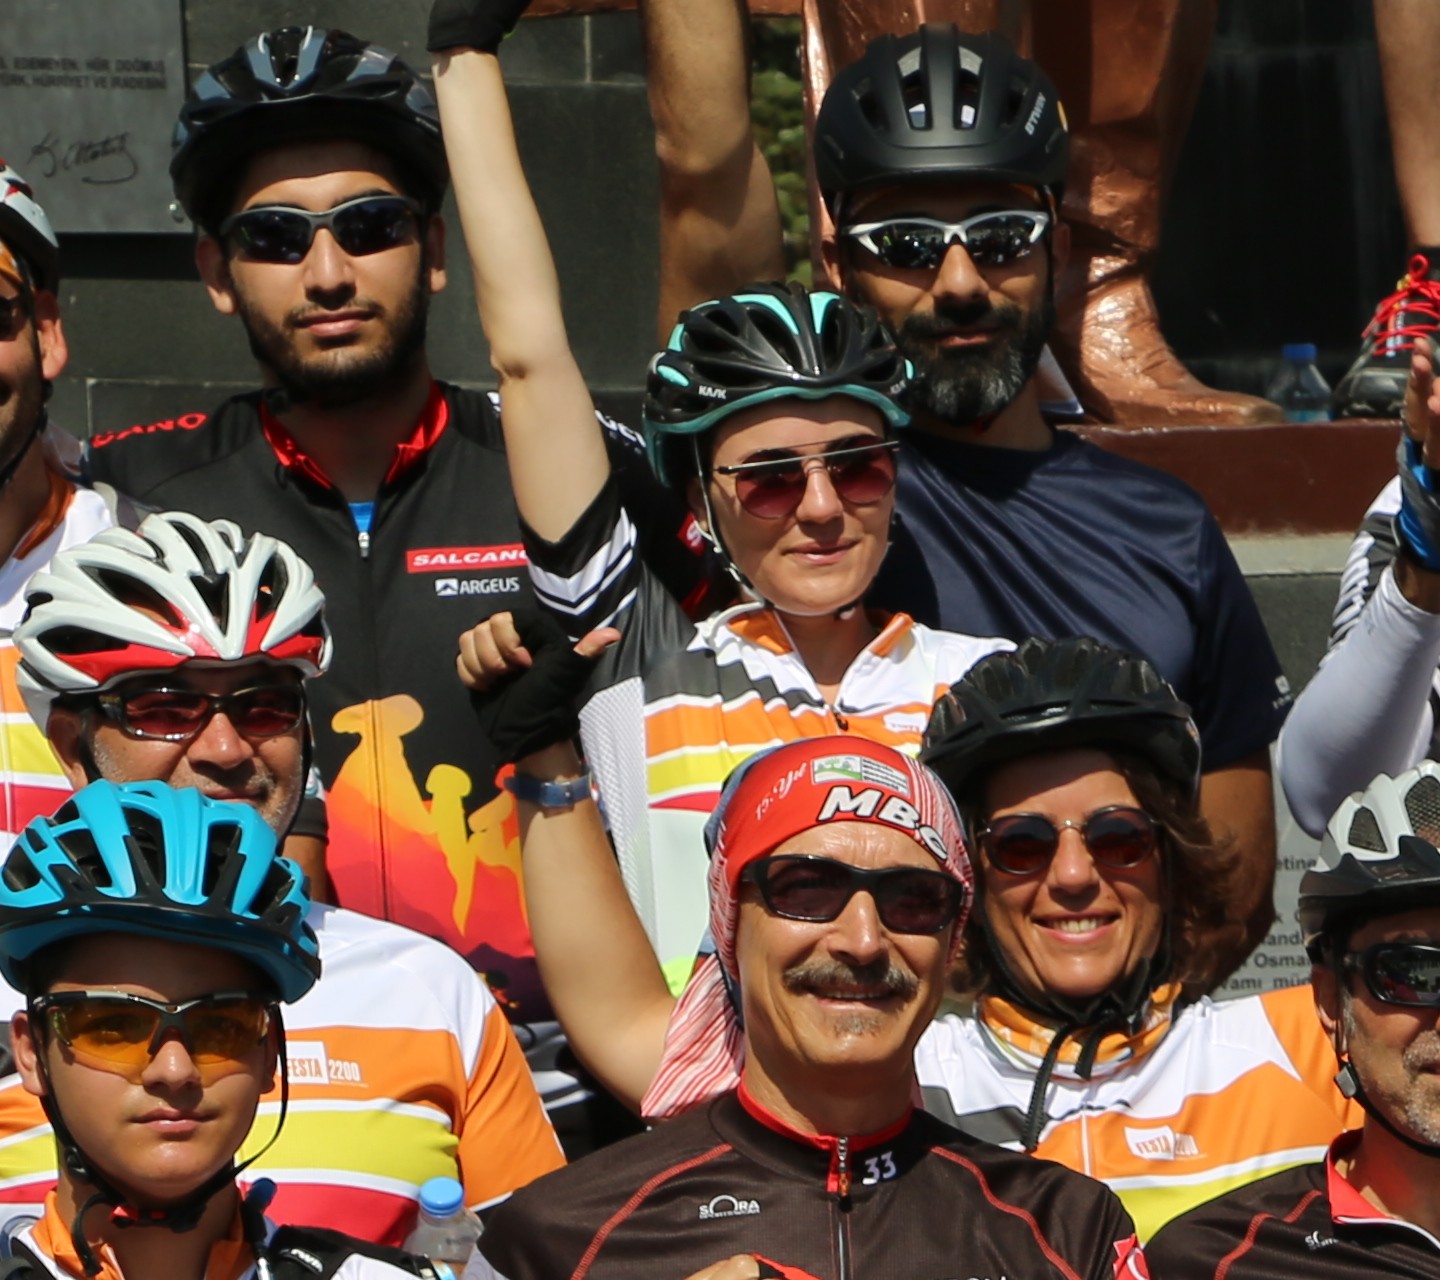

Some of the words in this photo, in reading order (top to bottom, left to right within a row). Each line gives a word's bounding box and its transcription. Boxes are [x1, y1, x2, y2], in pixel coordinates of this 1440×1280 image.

[459, 577, 519, 596] ARGEUS
[328, 1059, 361, 1083] 2200
[861, 1151, 897, 1186] 33
